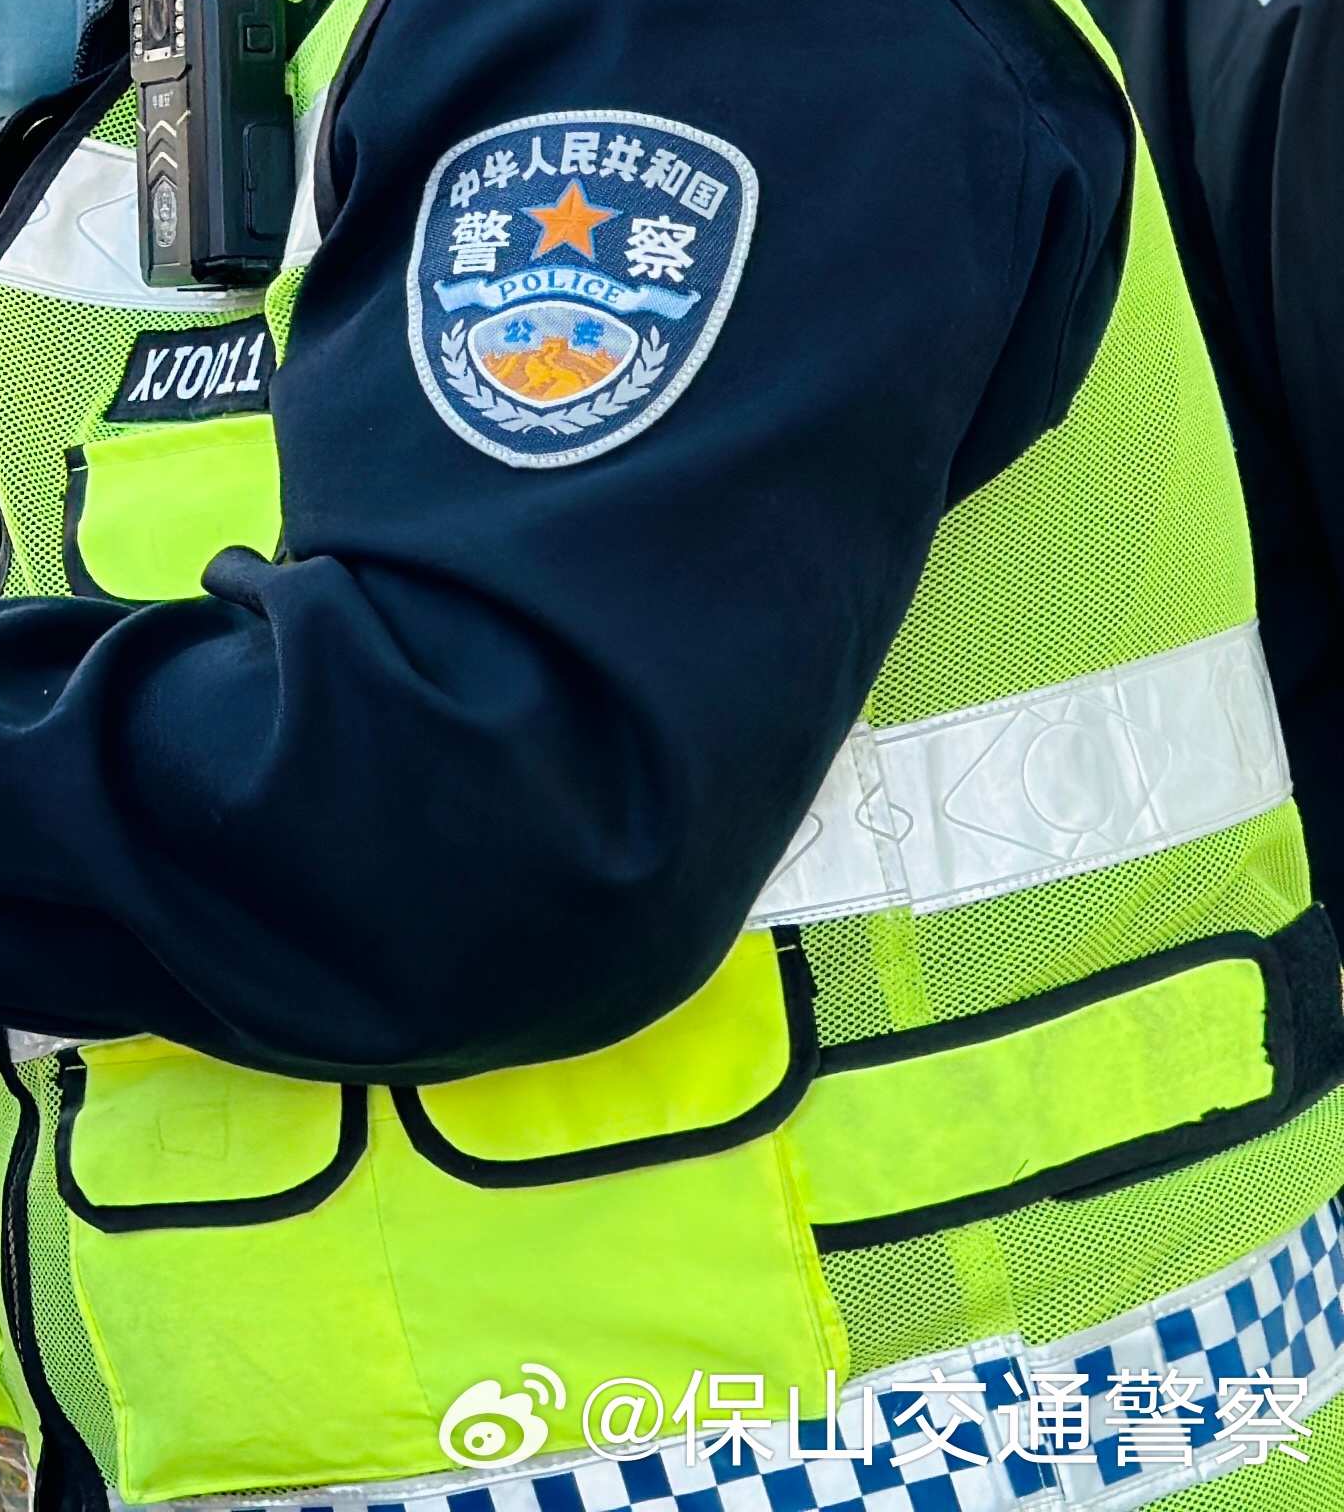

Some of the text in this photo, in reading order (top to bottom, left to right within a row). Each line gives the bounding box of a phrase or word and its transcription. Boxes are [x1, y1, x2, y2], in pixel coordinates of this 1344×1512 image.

[451, 131, 730, 221] 中华人民共和国
[499, 271, 623, 306] POLICE
